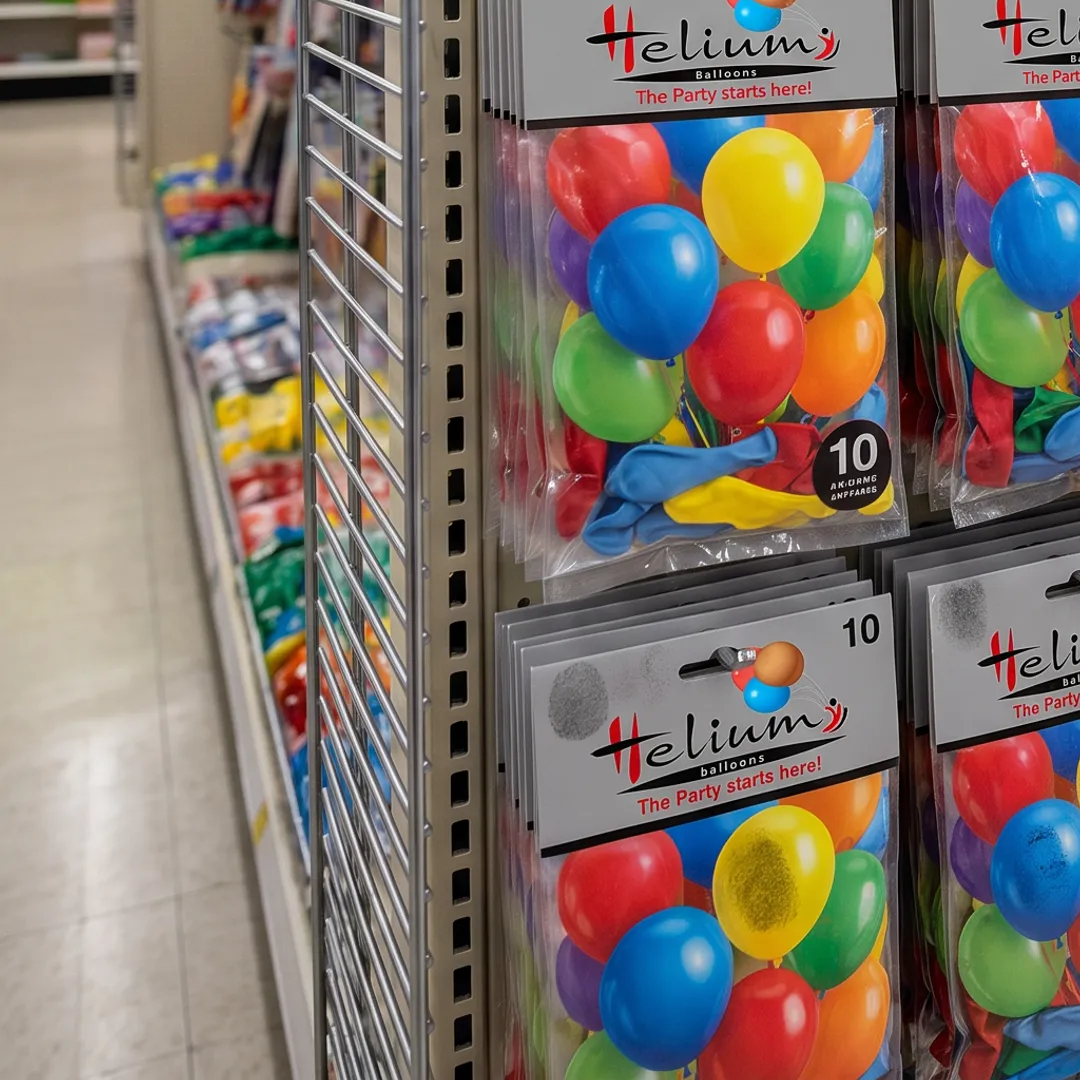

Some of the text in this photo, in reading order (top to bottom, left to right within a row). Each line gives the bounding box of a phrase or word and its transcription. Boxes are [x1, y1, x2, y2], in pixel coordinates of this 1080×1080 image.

[585, 3, 819, 74] Helium
[695, 68, 757, 80] Balloons
[1022, 71, 1049, 85] The
[635, 81, 812, 105] The Party starts here!
[829, 432, 878, 475] 10
[842, 613, 880, 648] 10
[1012, 704, 1039, 719] The
[1044, 692, 1080, 712] Party
[590, 712, 824, 784] Helium
[700, 753, 765, 778] balloons
[637, 755, 822, 816] The Party starts here!
